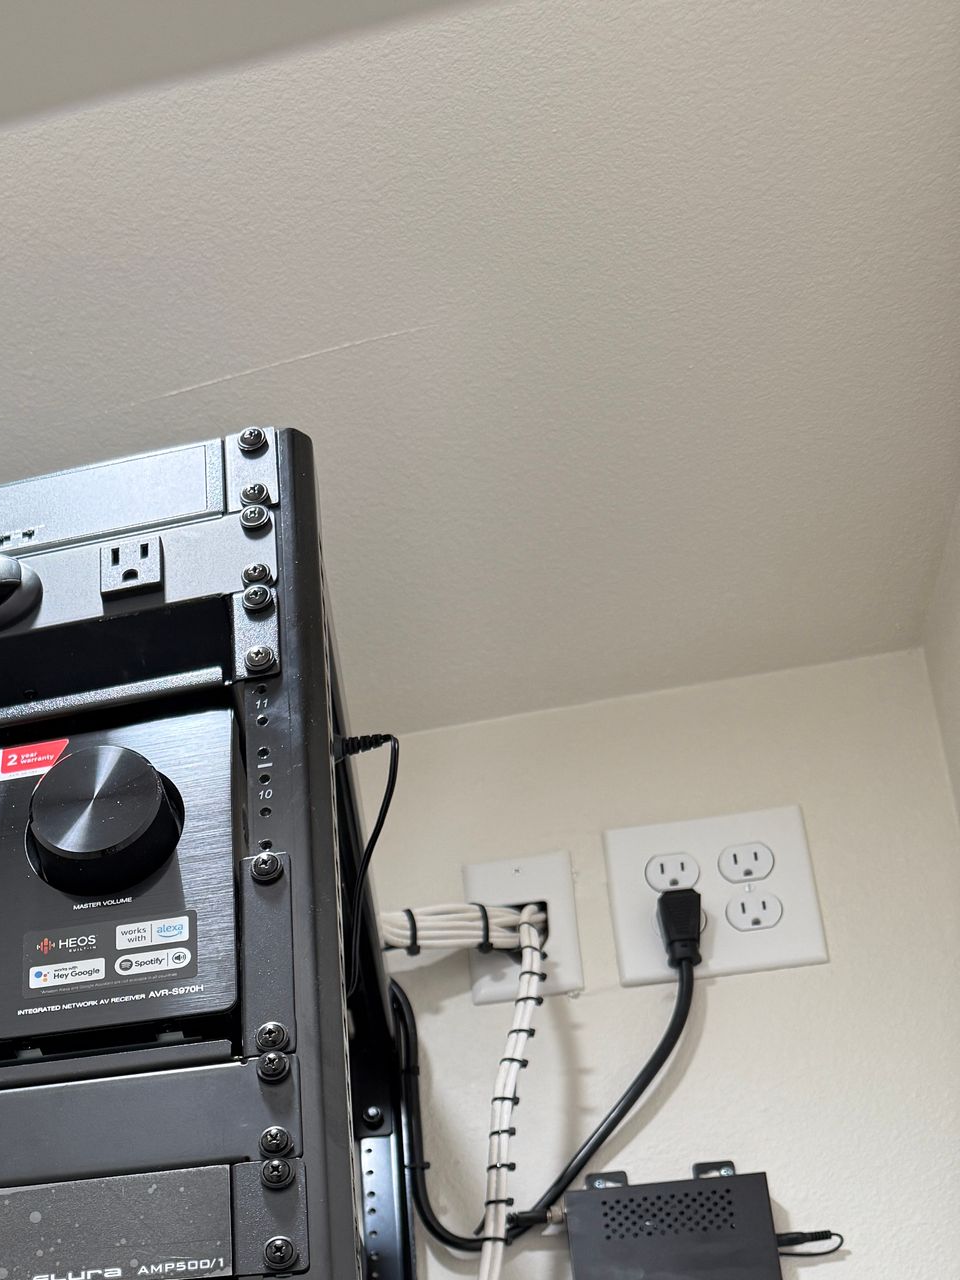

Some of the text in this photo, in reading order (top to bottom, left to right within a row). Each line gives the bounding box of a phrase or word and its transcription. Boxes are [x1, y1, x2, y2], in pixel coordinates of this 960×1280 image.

[255, 698, 269, 709] 11
[7, 754, 18, 767] 2
[20, 754, 55, 765] warranty
[258, 789, 273, 800] 10
[73, 896, 133, 911] MASTER VOLUME
[120, 926, 147, 937] works
[156, 923, 184, 934] alexa
[58, 935, 96, 950] HEOS
[127, 935, 146, 943] with
[134, 958, 163, 970] Spotify
[53, 967, 100, 982] Hey Google
[17, 1005, 61, 1016] INTEGRATED
[62, 1000, 98, 1010] NETWORK
[111, 994, 146, 1003] RECEIVER
[148, 984, 204, 999] AVR-S970H
